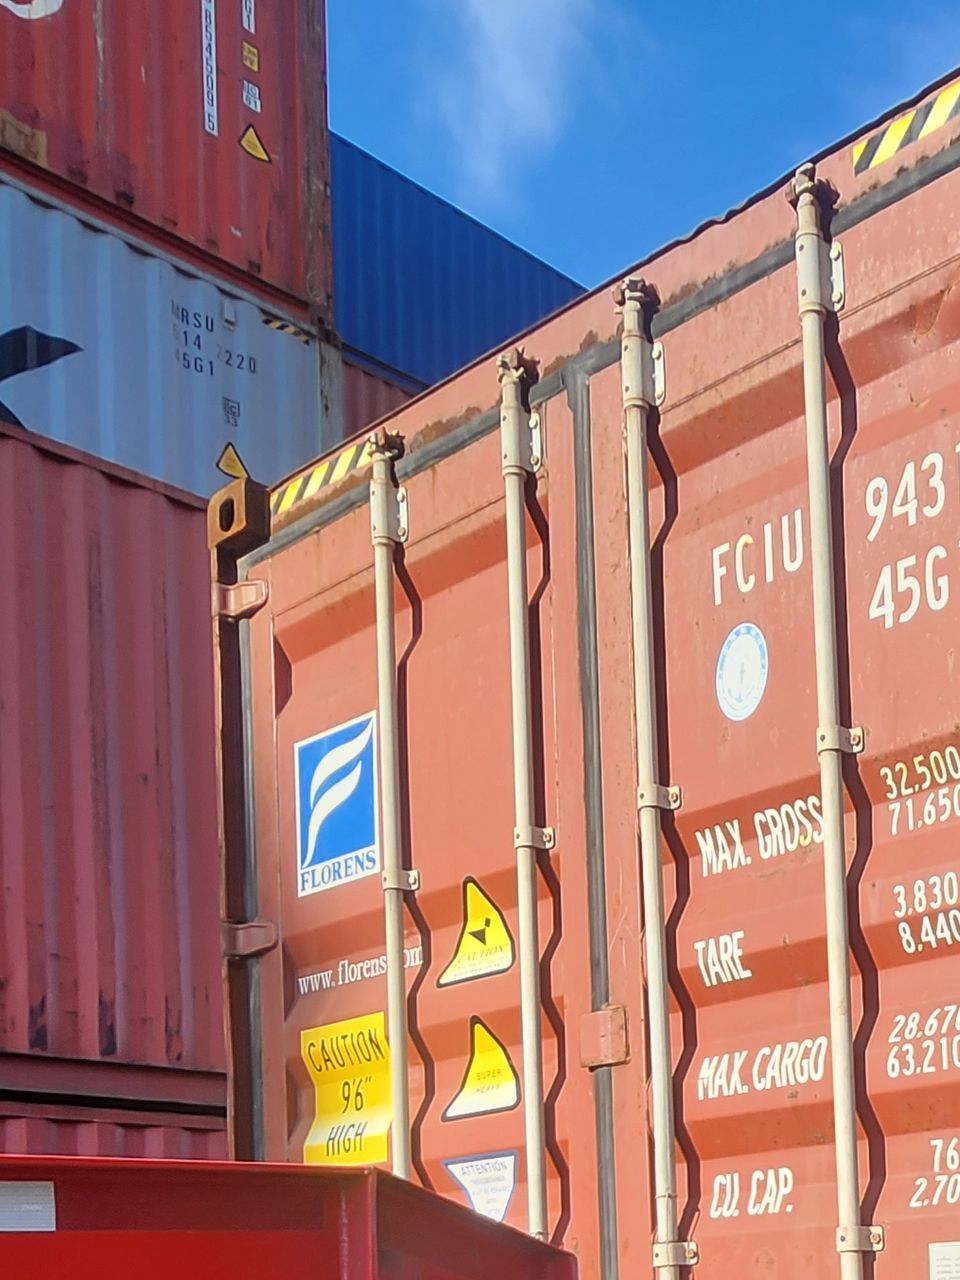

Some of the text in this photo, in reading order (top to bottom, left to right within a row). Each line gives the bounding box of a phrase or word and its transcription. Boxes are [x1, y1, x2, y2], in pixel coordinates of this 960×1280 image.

[207, 113, 215, 131] 5
[711, 508, 804, 606] FCIU
[694, 795, 825, 878] MAX. GROSS
[301, 850, 377, 891] FLORENS
[893, 872, 959, 918] 3.830
[694, 930, 752, 988] TARE
[307, 1028, 385, 1073] CAUTION
[697, 1036, 828, 1101] MAX. CARGO
[476, 1068, 502, 1081] SUPER
[326, 1121, 368, 1157] HIGH
[461, 1160, 507, 1177] ATTENTION
[710, 1167, 794, 1219] CU. CAP.
